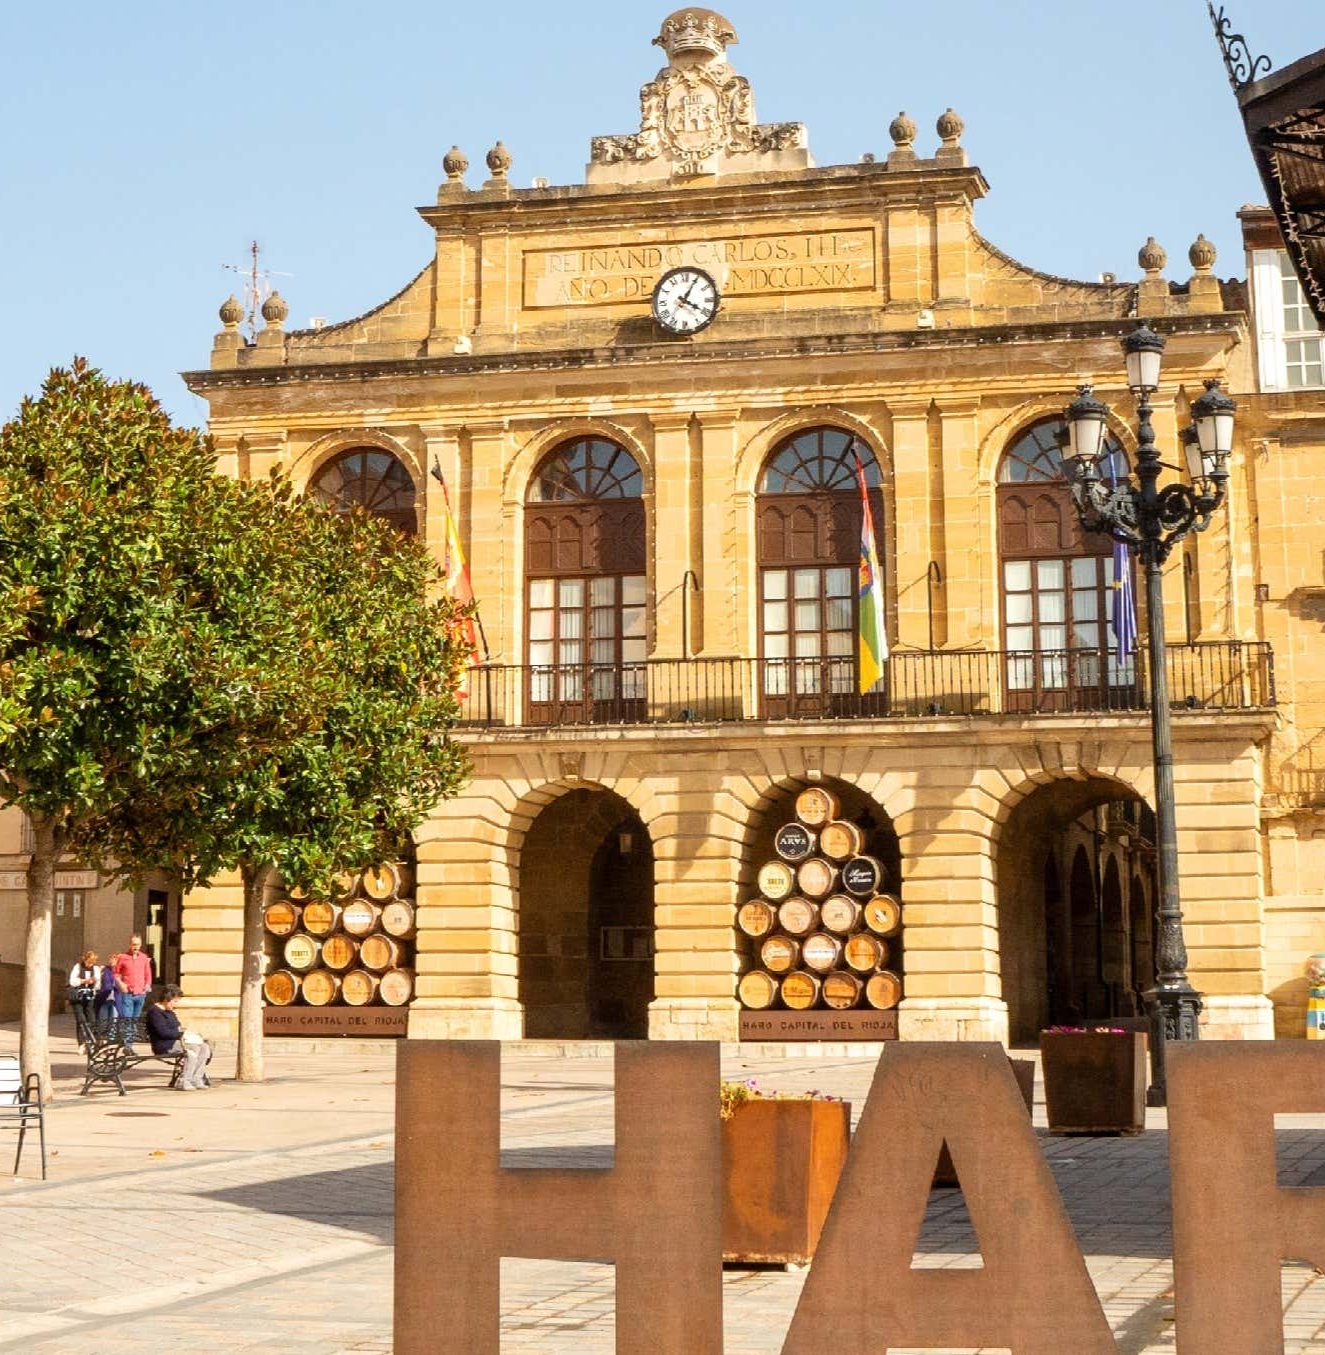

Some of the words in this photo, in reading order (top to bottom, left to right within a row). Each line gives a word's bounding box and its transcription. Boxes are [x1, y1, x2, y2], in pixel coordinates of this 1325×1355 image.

[624, 276, 654, 297] DE
[266, 1016, 293, 1024] HARO
[299, 1016, 342, 1025] CAPITAL
[348, 1016, 367, 1025] DEL
[374, 1016, 405, 1025] RIOJA
[742, 1021, 772, 1030] HARO
[780, 1021, 825, 1030] CAPITAL
[832, 1021, 854, 1030] DEL
[861, 1021, 895, 1030] RIOJA
